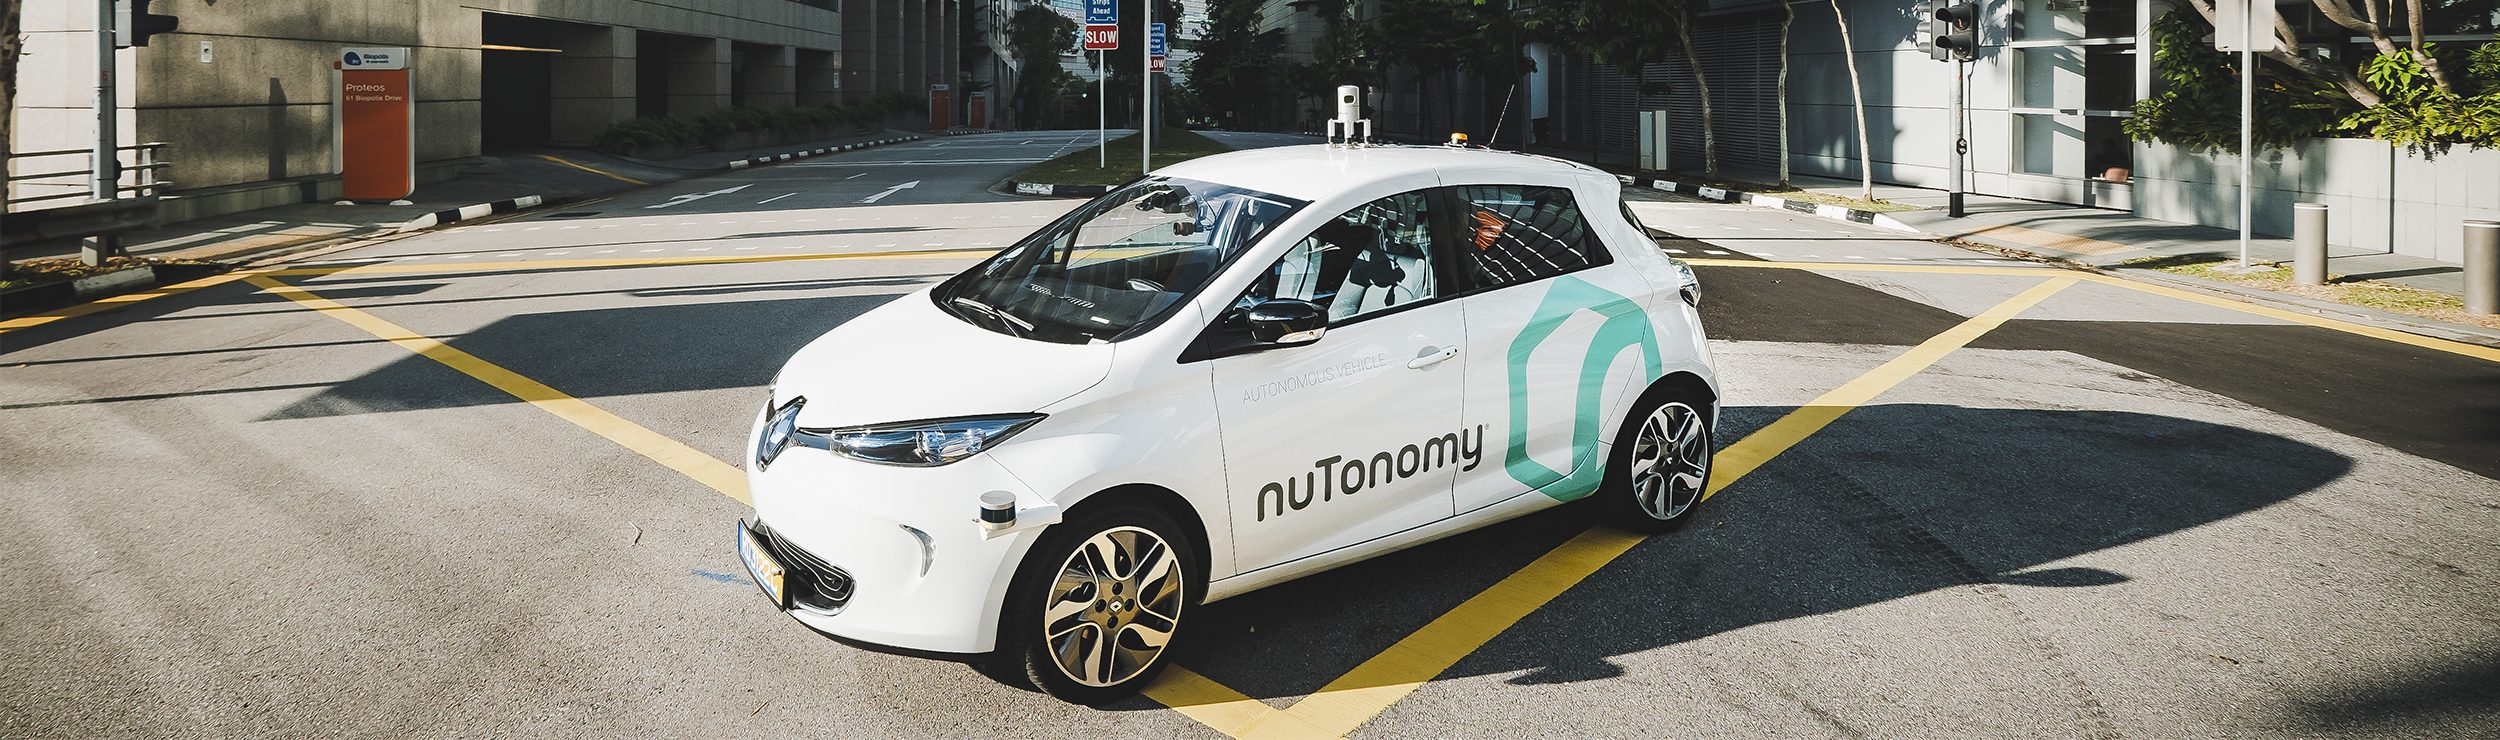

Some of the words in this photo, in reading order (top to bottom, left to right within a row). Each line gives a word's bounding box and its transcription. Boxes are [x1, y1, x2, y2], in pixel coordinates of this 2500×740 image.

[1086, 31, 1117, 44] SLOW
[1149, 59, 1164, 68] LOW
[345, 83, 386, 92] Proteos
[355, 95, 383, 103] Biopolis
[1242, 366, 1335, 405] AUTONOMOUS
[1335, 352, 1387, 378] VEHICLE
[1257, 424, 1483, 523] nuTonomy
